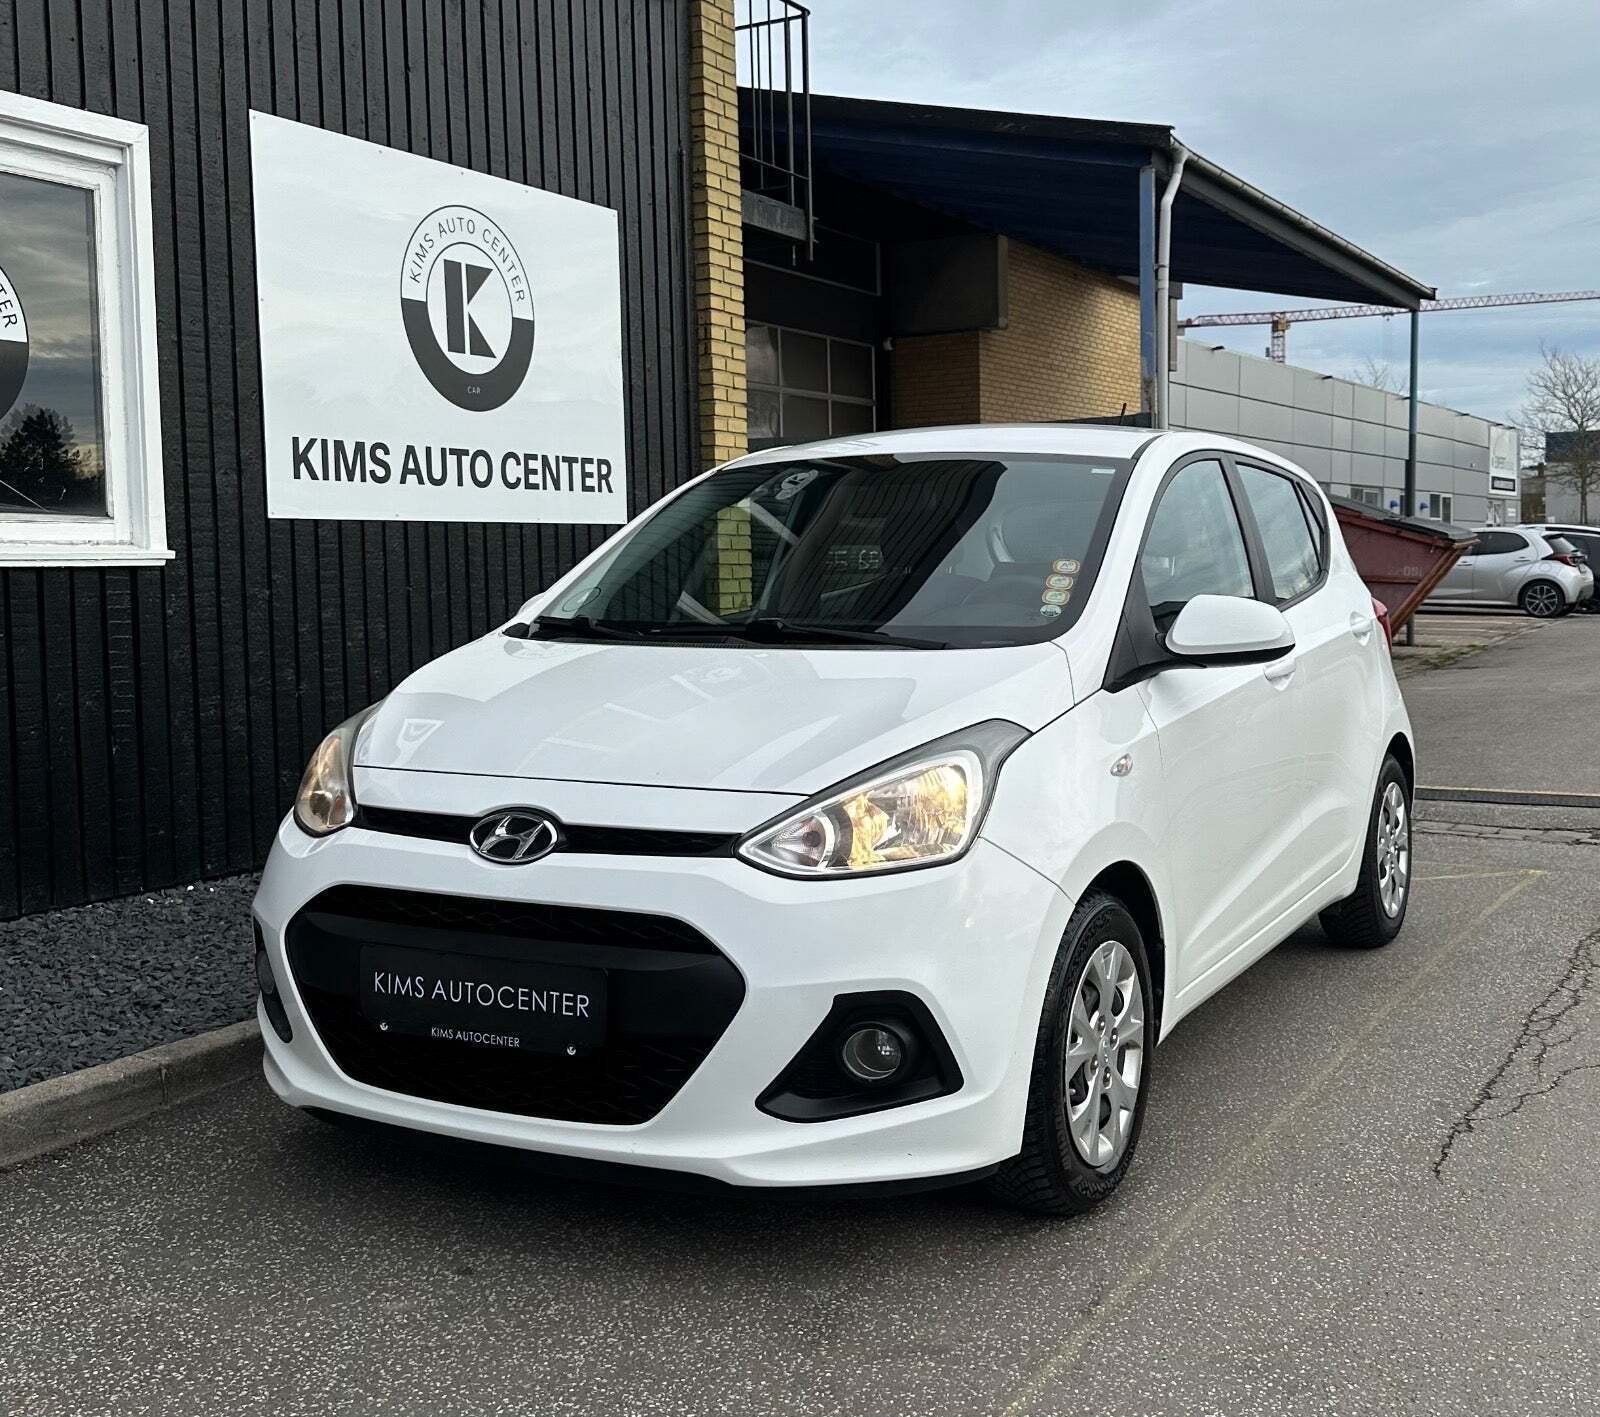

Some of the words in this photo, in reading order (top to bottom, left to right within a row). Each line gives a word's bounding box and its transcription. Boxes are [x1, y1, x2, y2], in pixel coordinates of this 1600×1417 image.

[410, 233, 435, 284] KIMS
[438, 217, 475, 238] AUTO
[482, 229, 525, 302] CENTER
[467, 385, 481, 395] CAR
[291, 436, 392, 484] KIMS
[399, 444, 494, 489] AUTO
[500, 451, 614, 494] CENTER
[374, 971, 425, 998] KIMS
[431, 979, 590, 1018] AUTOCENTER
[431, 1027, 453, 1039] KIMS
[456, 1031, 520, 1048] AUTOCENTER
